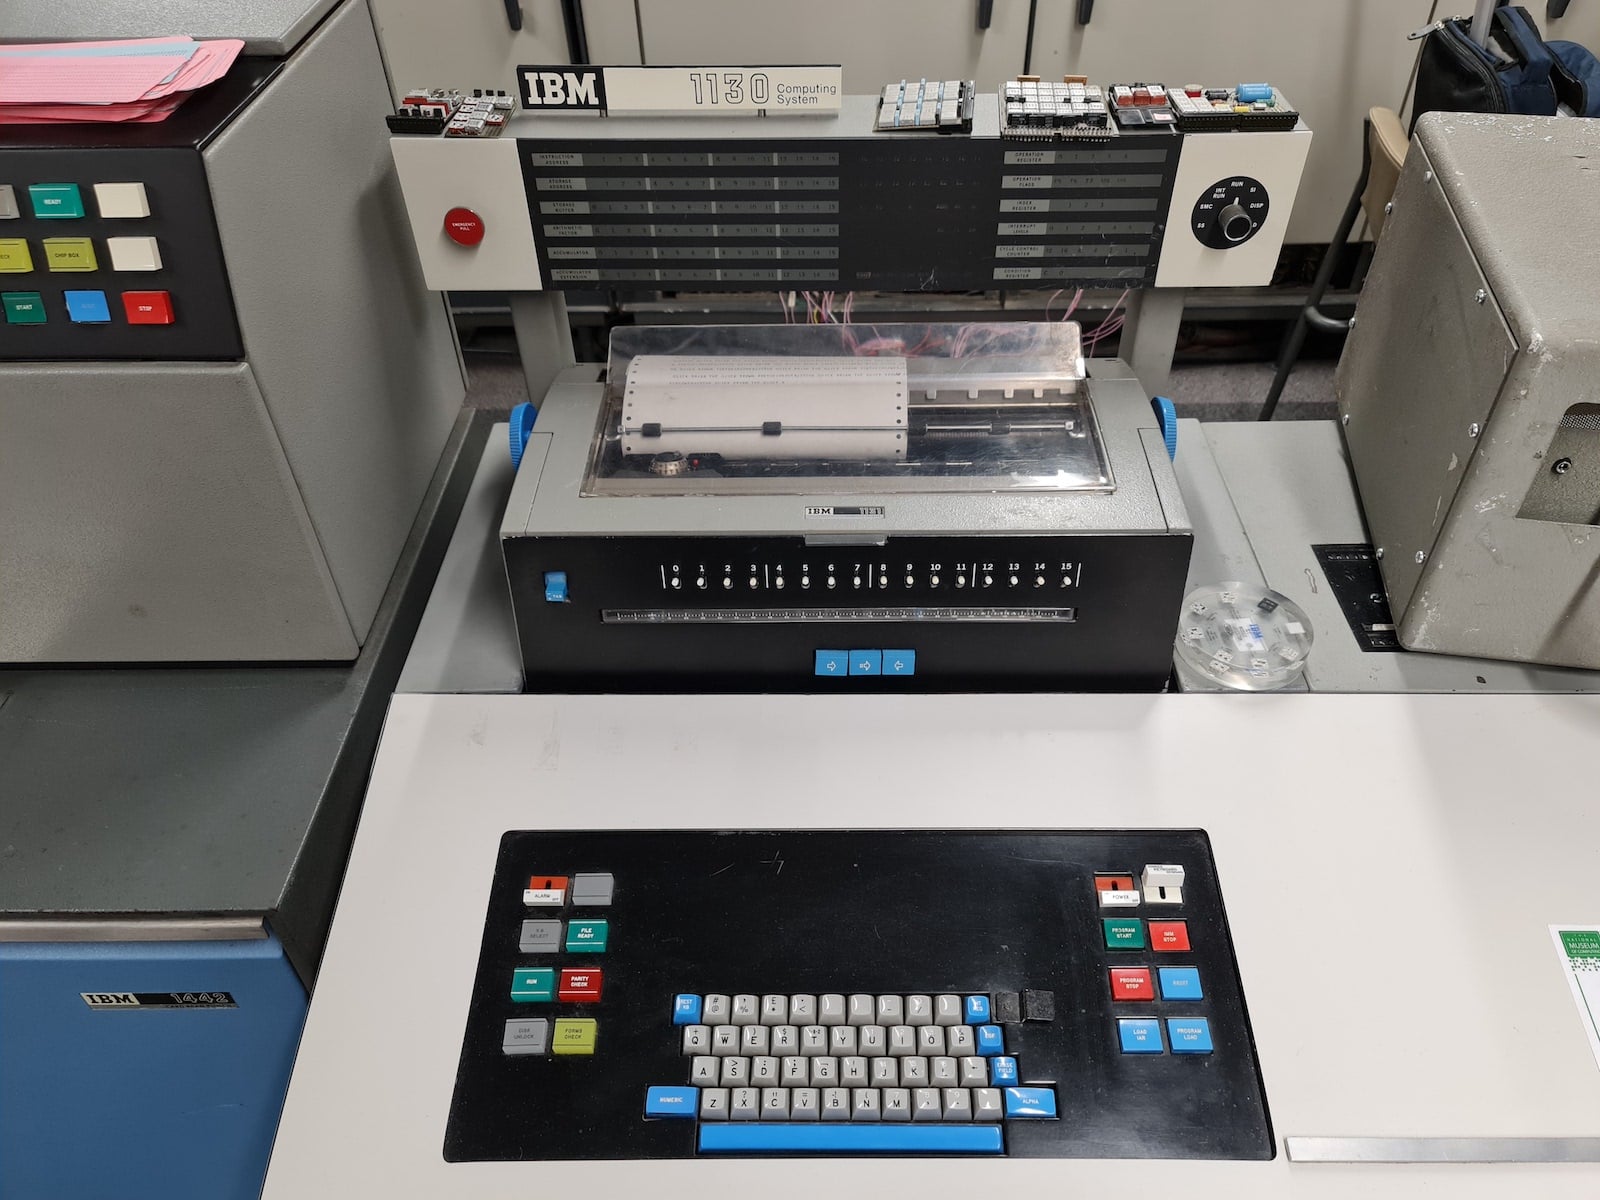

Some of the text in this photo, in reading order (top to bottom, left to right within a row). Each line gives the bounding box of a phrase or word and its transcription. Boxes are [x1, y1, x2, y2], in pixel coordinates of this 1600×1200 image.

[524, 72, 770, 106] IBM 1130
[776, 82, 837, 96] Computing
[776, 94, 818, 105] System
[672, 564, 679, 572] 0
[699, 564, 705, 572] 1
[724, 564, 731, 572] 2
[750, 564, 757, 572] 3
[776, 564, 783, 572] 4
[802, 564, 809, 572] 5
[828, 564, 835, 572] 6
[854, 563, 861, 571] 7
[880, 563, 887, 571] 8
[906, 563, 913, 571] 9
[930, 563, 941, 571] 10
[956, 563, 966, 571] 11
[982, 563, 993, 571] 12
[1008, 563, 1020, 571] 13
[1034, 563, 1046, 571] 14
[86, 993, 229, 1004] IBM 1442
[711, 1004, 720, 1013] @
[740, 1005, 749, 1013] %
[691, 1036, 699, 1045] Q
[721, 1036, 729, 1045] W
[750, 1036, 758, 1045] E
[781, 1036, 788, 1045] R
[811, 1036, 817, 1045] T
[840, 1036, 846, 1045] Y
[869, 1036, 876, 1044] U
[958, 1036, 965, 1045] P
[700, 1067, 707, 1076] A
[730, 1067, 737, 1076] S
[760, 1067, 768, 1076] D
[791, 1067, 798, 1076] F
[820, 1067, 828, 1076] G
[850, 1067, 857, 1076] H
[881, 1068, 887, 1077] J
[911, 1067, 918, 1076] K
[710, 1099, 717, 1108] Z
[741, 1099, 747, 1107] X
[771, 1098, 778, 1107] C
[801, 1099, 808, 1107] V
[832, 1098, 839, 1107] B
[863, 1099, 870, 1108] N
[893, 1100, 901, 1108] M
